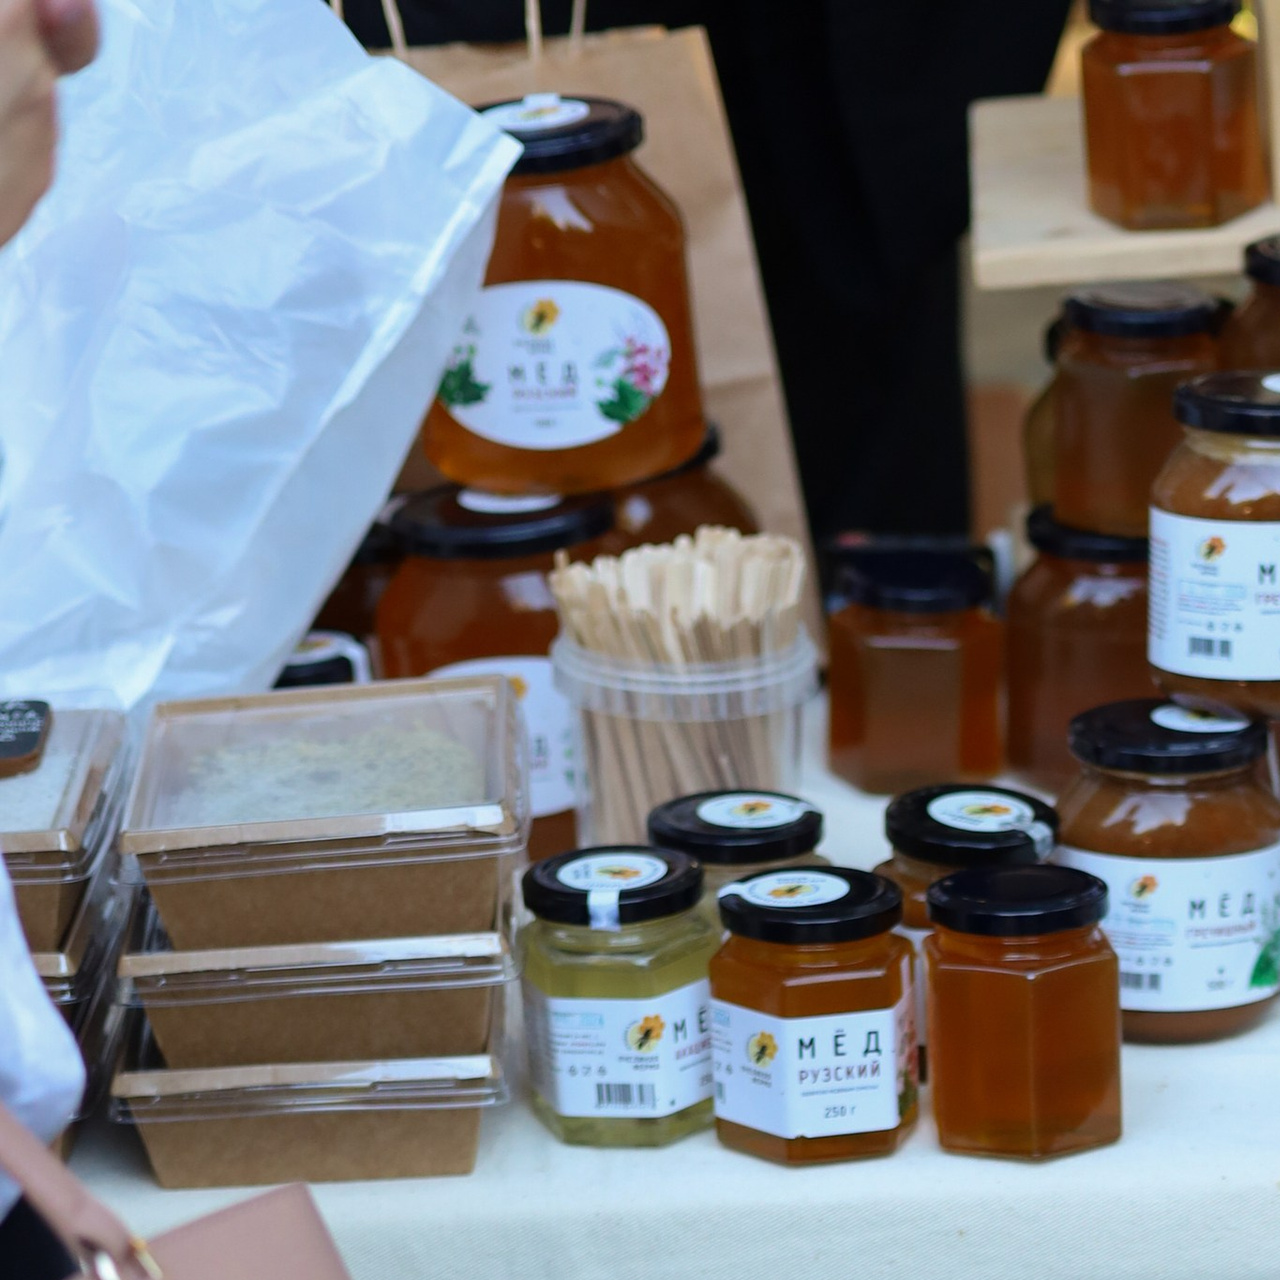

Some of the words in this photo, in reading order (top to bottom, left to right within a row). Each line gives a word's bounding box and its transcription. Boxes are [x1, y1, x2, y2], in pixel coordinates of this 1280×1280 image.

[1189, 893, 1257, 920] МЁД
[673, 1006, 707, 1043] МЁ
[798, 1028, 882, 1060] МЁД
[799, 1061, 881, 1085] РУЗСКИЙ
[824, 1106, 847, 1119] 250
